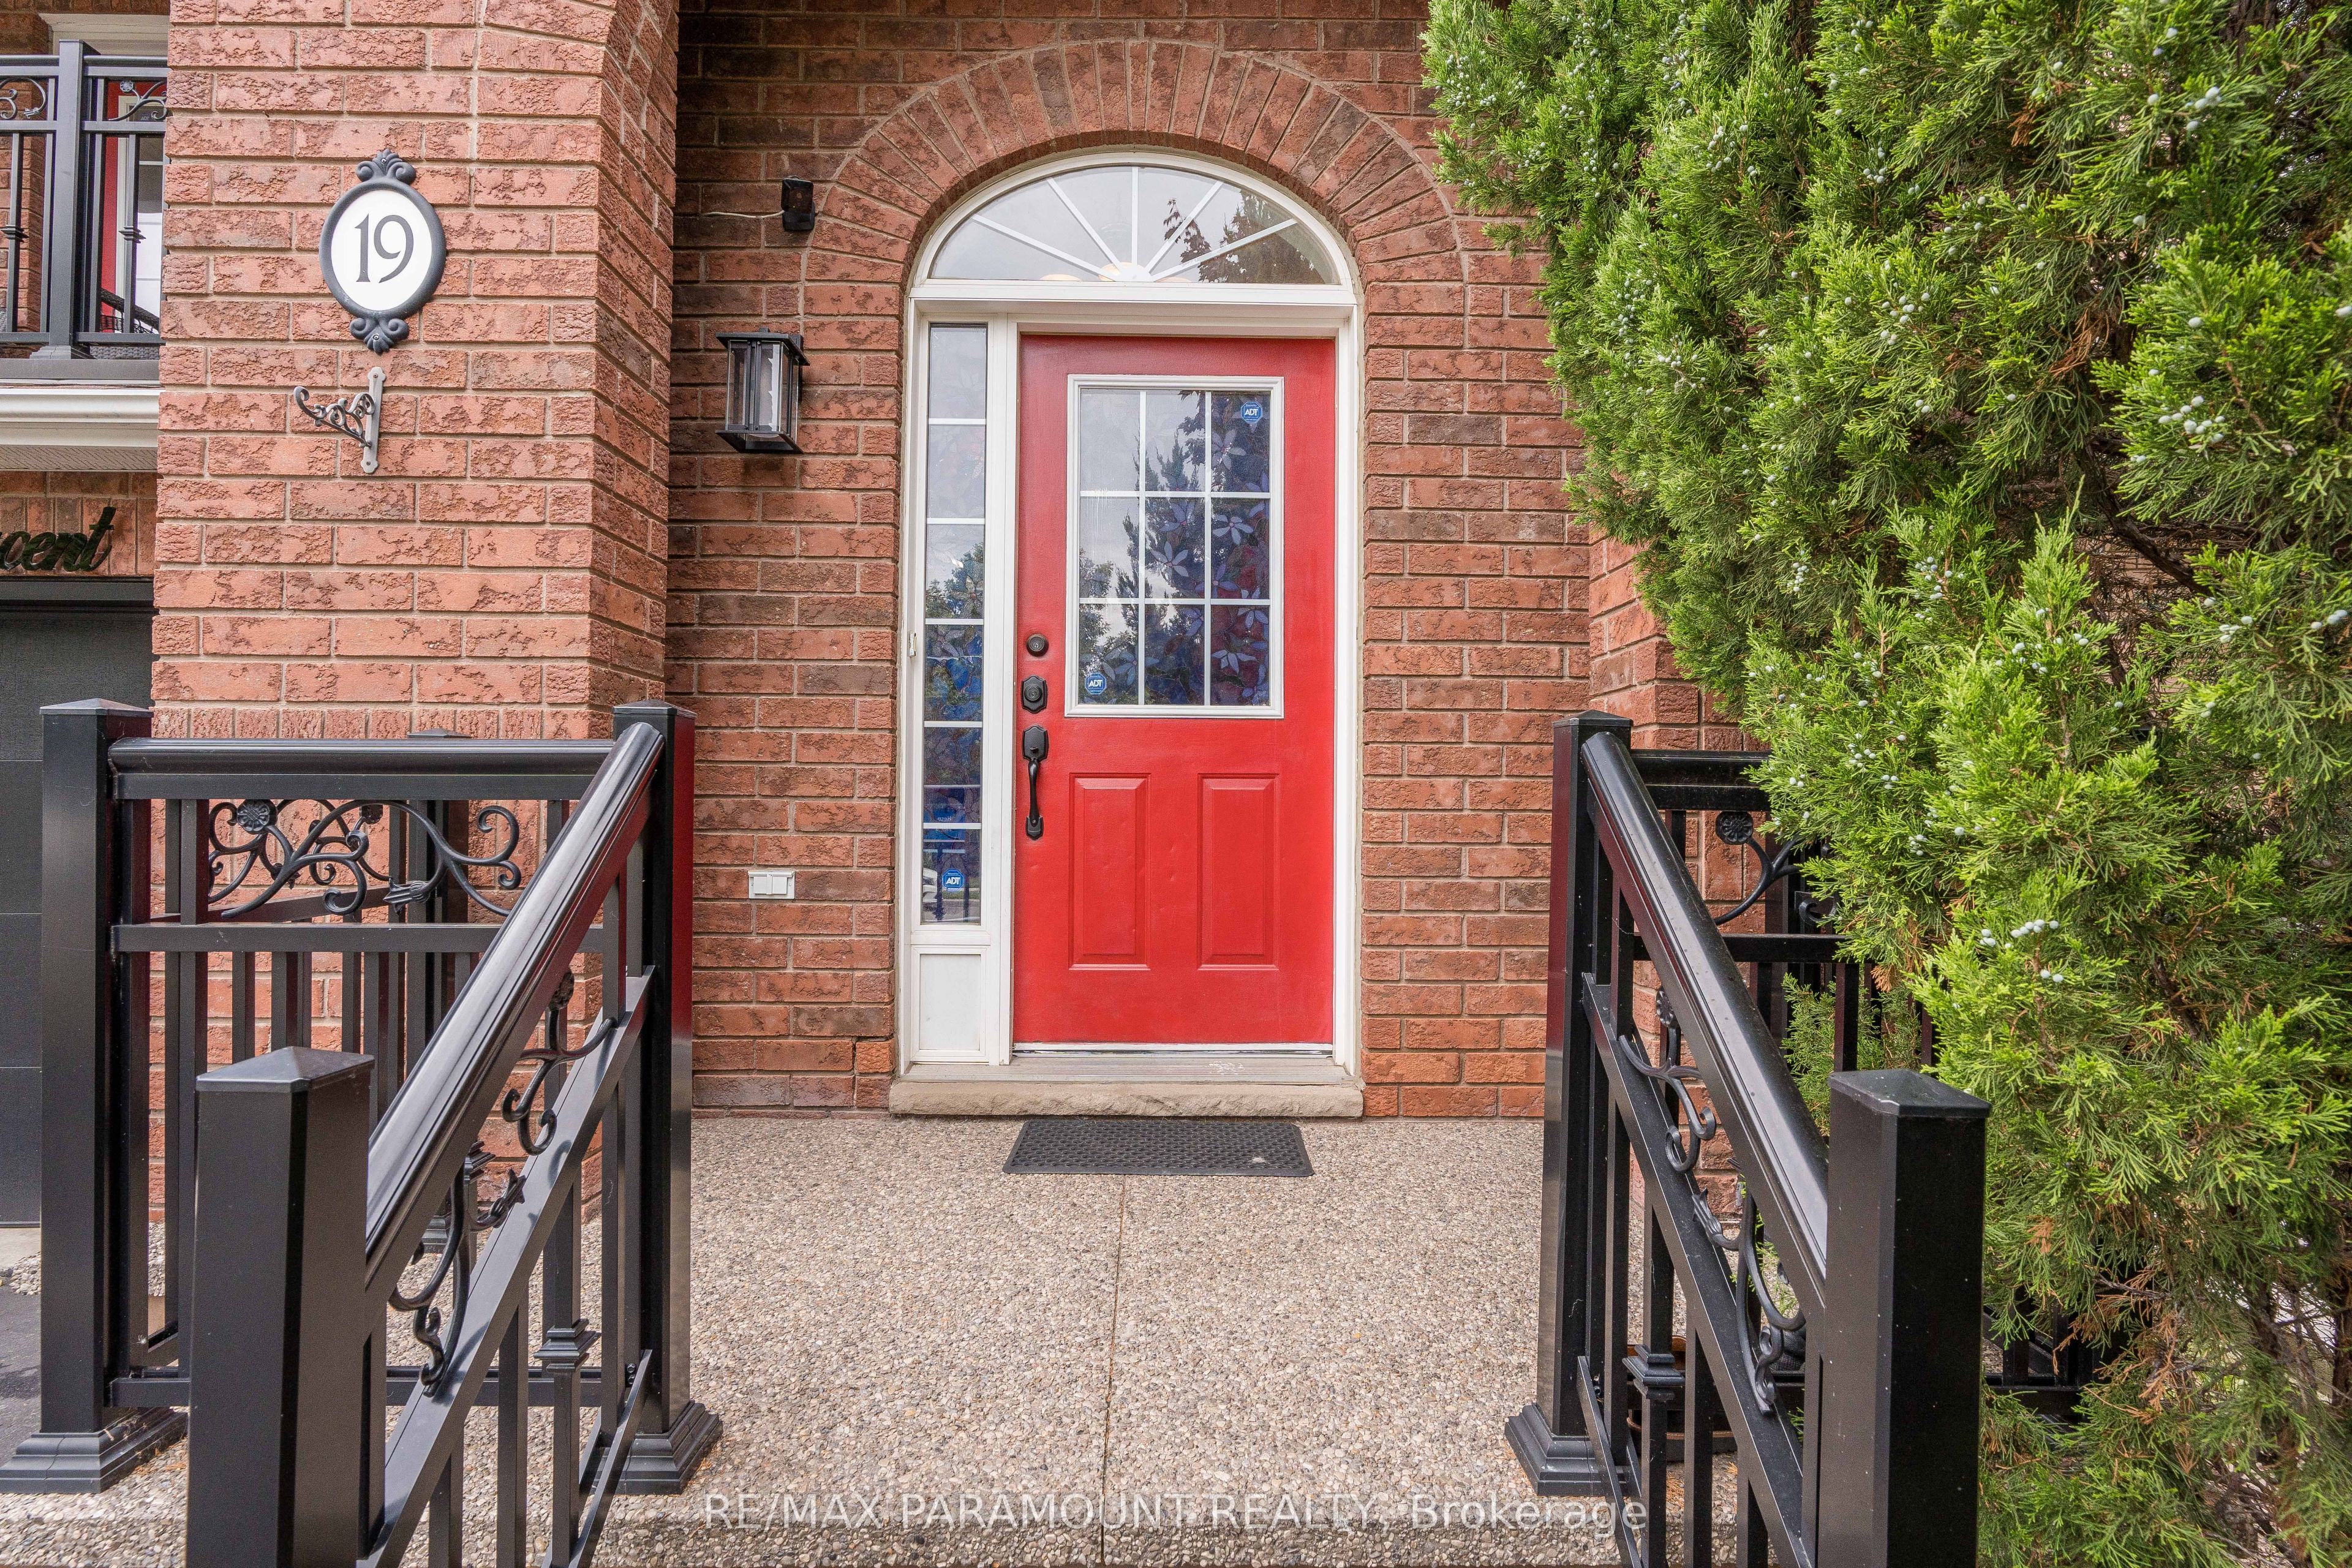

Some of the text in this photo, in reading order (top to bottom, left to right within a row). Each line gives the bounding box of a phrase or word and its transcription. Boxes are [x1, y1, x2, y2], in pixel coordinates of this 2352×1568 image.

[355, 213, 414, 284] 19
[0, 507, 116, 572] cent
[945, 876, 960, 885] ADT
